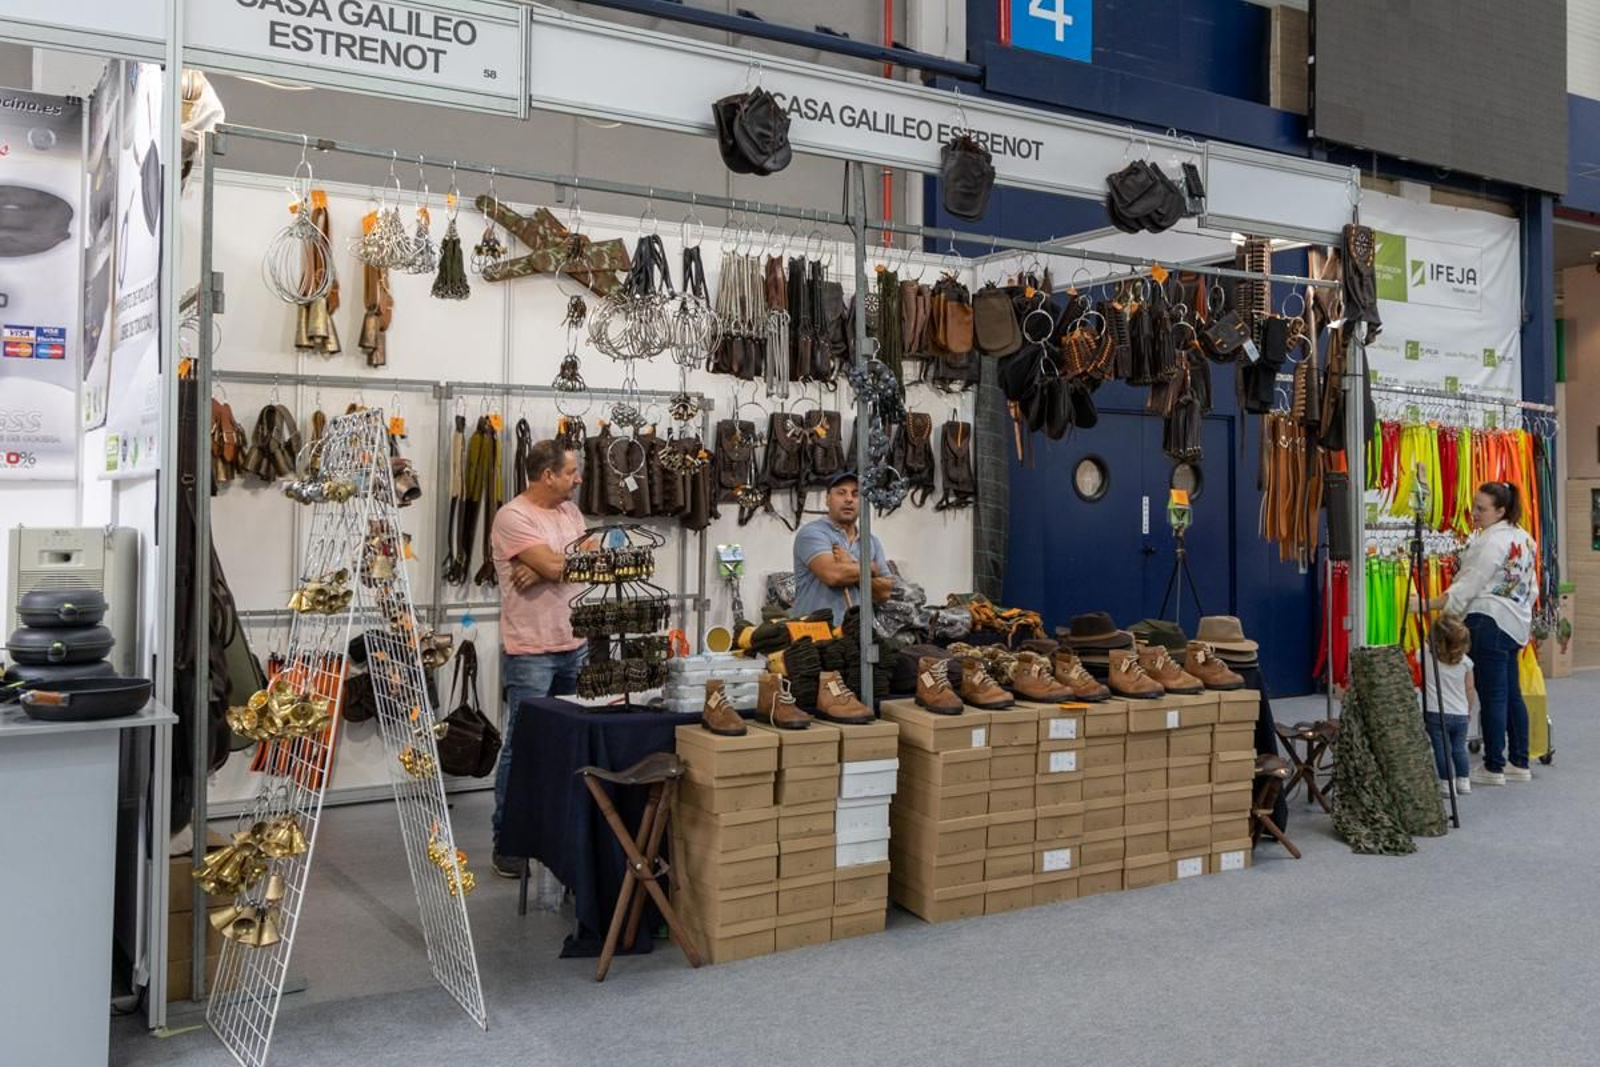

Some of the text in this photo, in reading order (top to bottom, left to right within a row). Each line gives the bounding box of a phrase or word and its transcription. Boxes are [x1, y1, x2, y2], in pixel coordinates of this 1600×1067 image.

[338, 2, 477, 46] GALILEO
[1028, 0, 1073, 42] 4
[269, 20, 447, 74] ESTRENOT
[483, 68, 498, 80] 58
[839, 104, 933, 142] GALILEO
[1429, 263, 1478, 286] IFEJA
[9, 329, 31, 338] VISA
[0, 450, 37, 466] 0%
